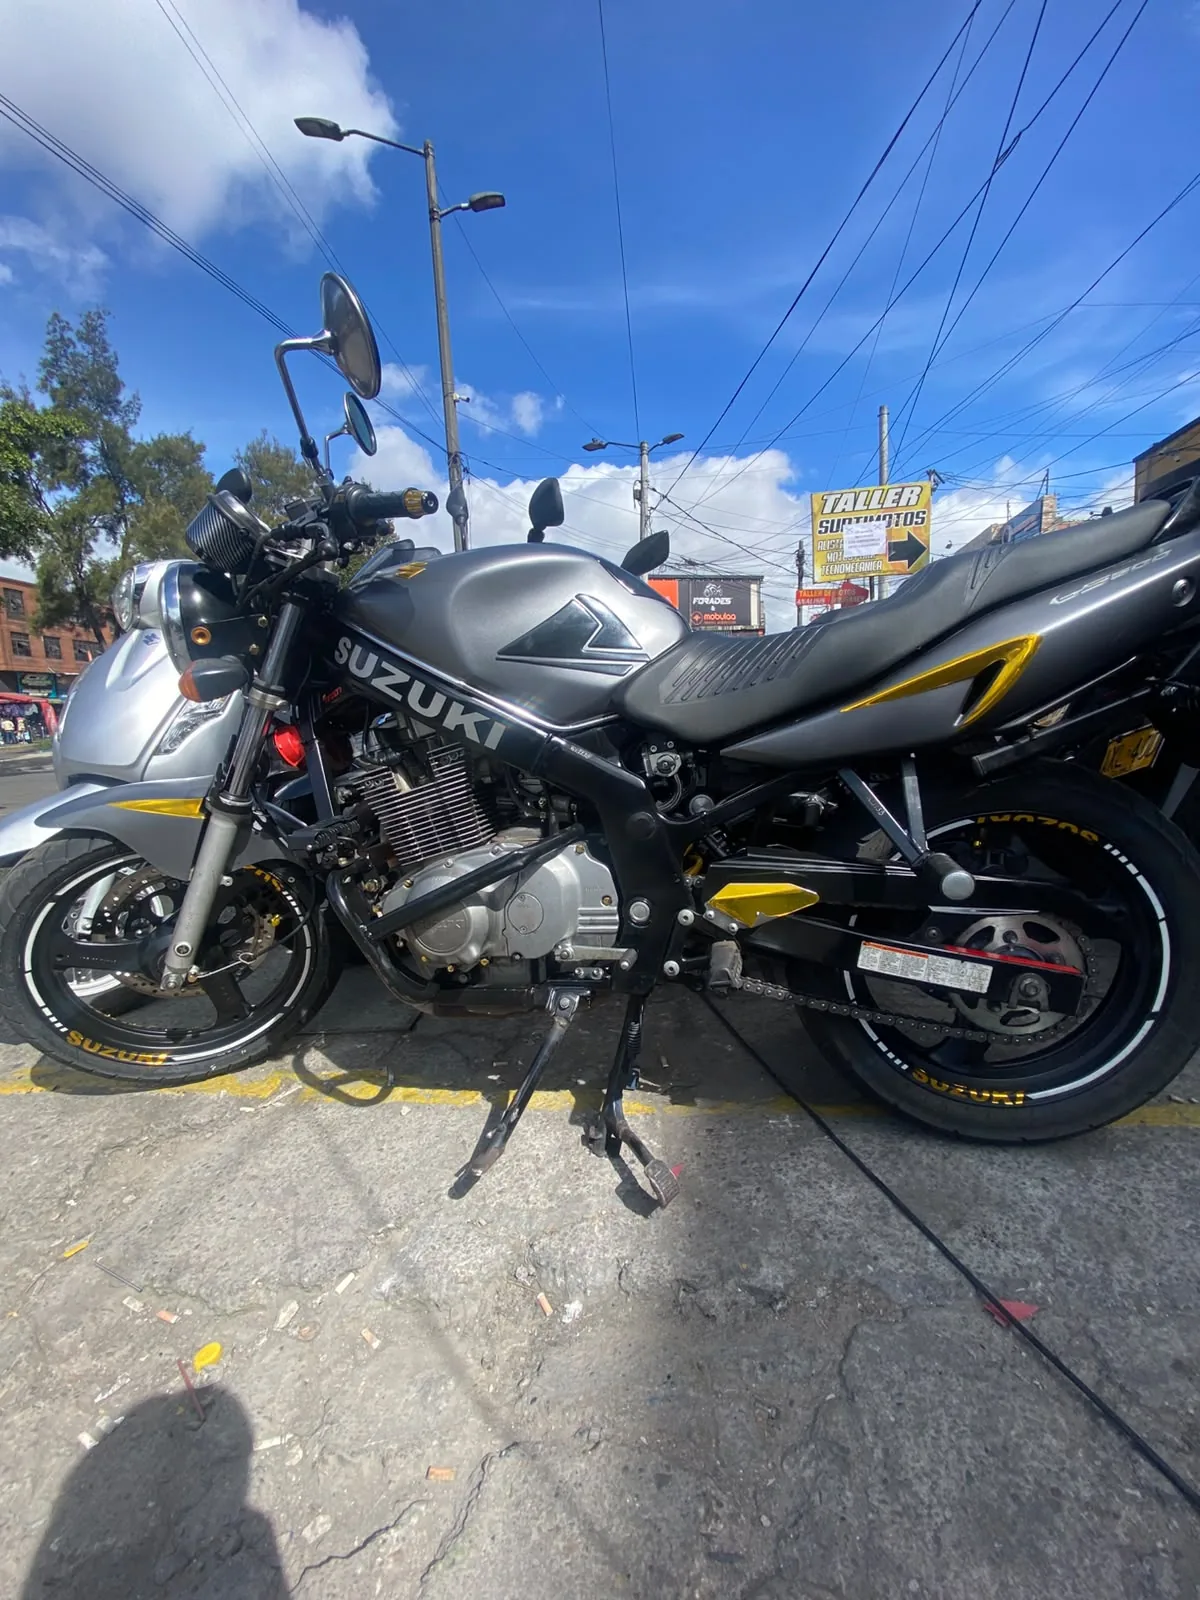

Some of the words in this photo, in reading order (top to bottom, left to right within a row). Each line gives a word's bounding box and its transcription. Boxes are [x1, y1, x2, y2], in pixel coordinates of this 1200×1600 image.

[821, 485, 922, 515] TALLER
[693, 597, 733, 605] FORADES
[334, 636, 506, 750] SUZUKI
[66, 1030, 169, 1066] SUZUKI
[911, 1068, 1025, 1106] SUZUKI
